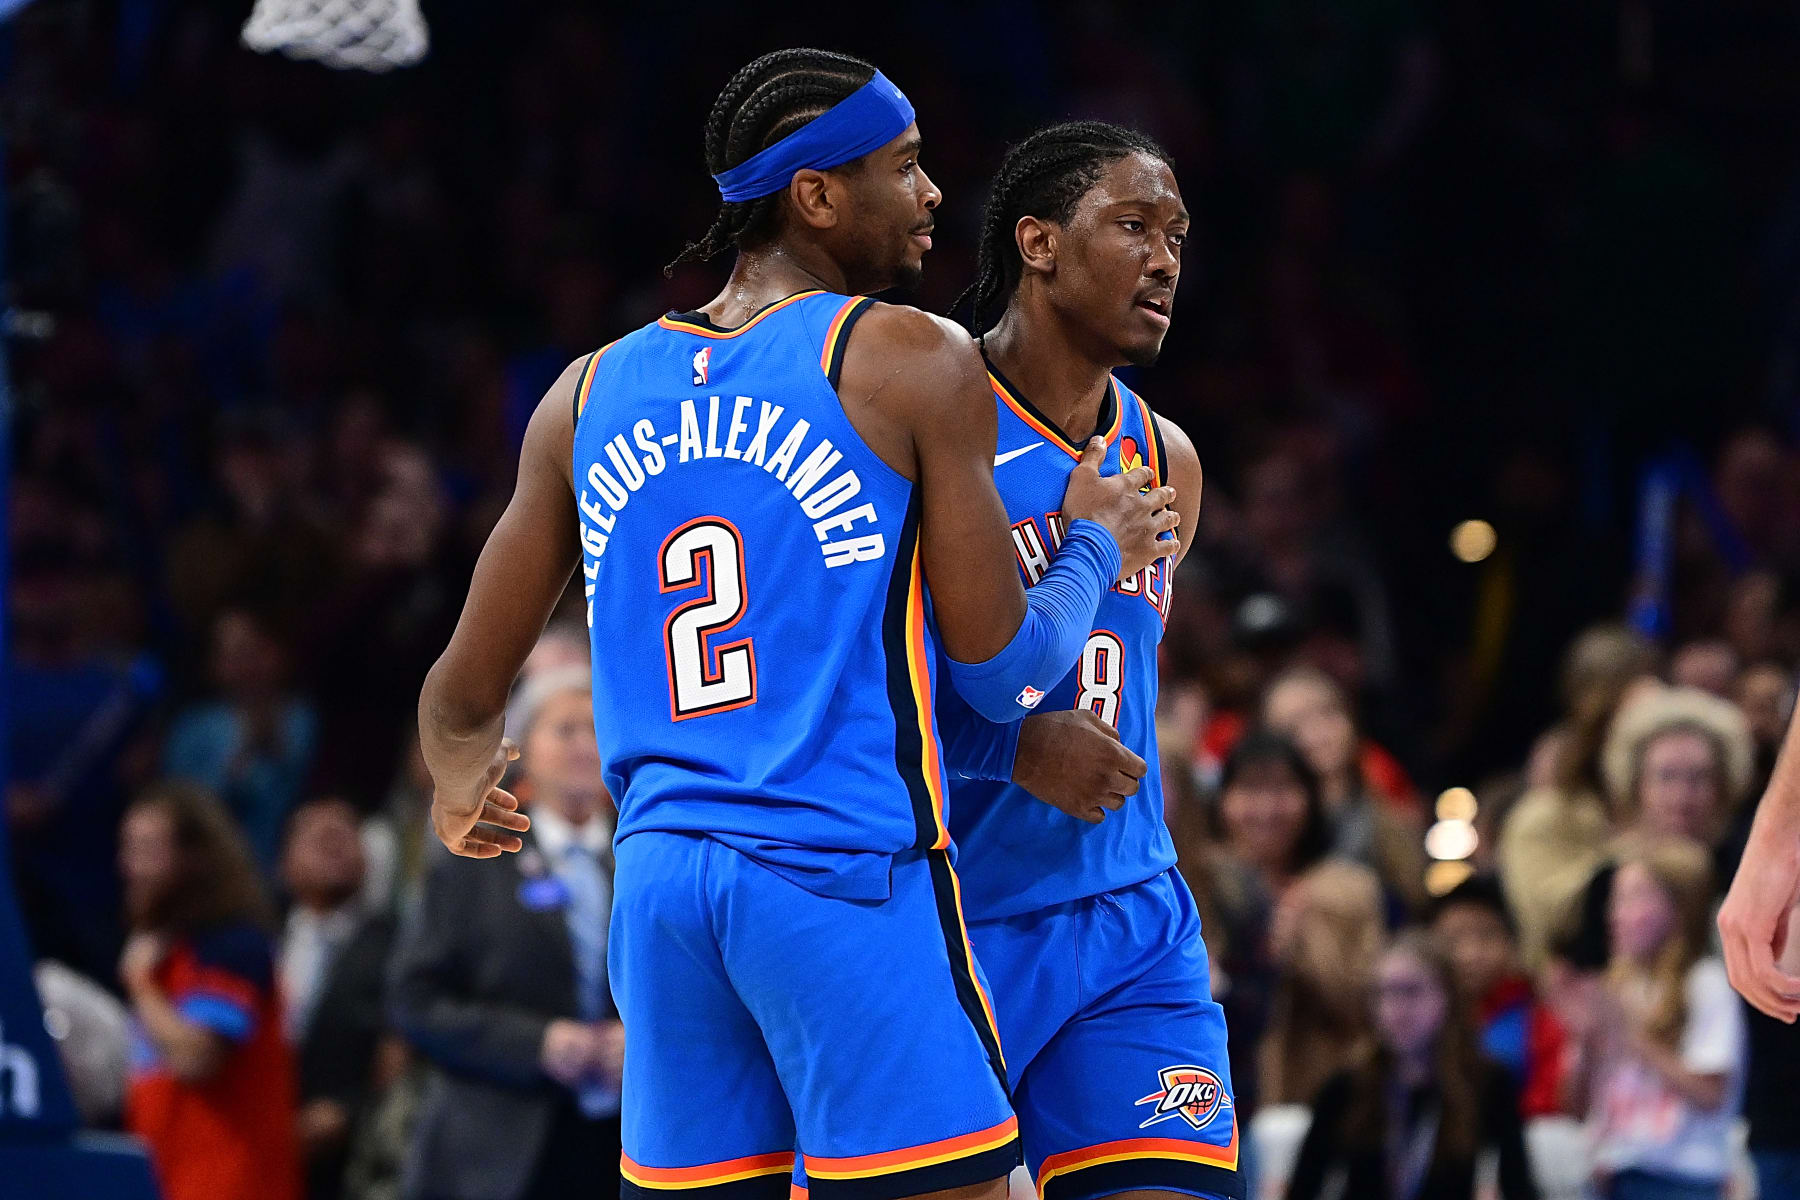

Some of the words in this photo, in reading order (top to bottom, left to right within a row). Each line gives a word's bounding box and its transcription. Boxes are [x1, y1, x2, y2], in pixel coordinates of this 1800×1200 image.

[657, 515, 758, 722] 2
[1075, 629, 1125, 729] 8
[1159, 1082, 1215, 1112] OKC
